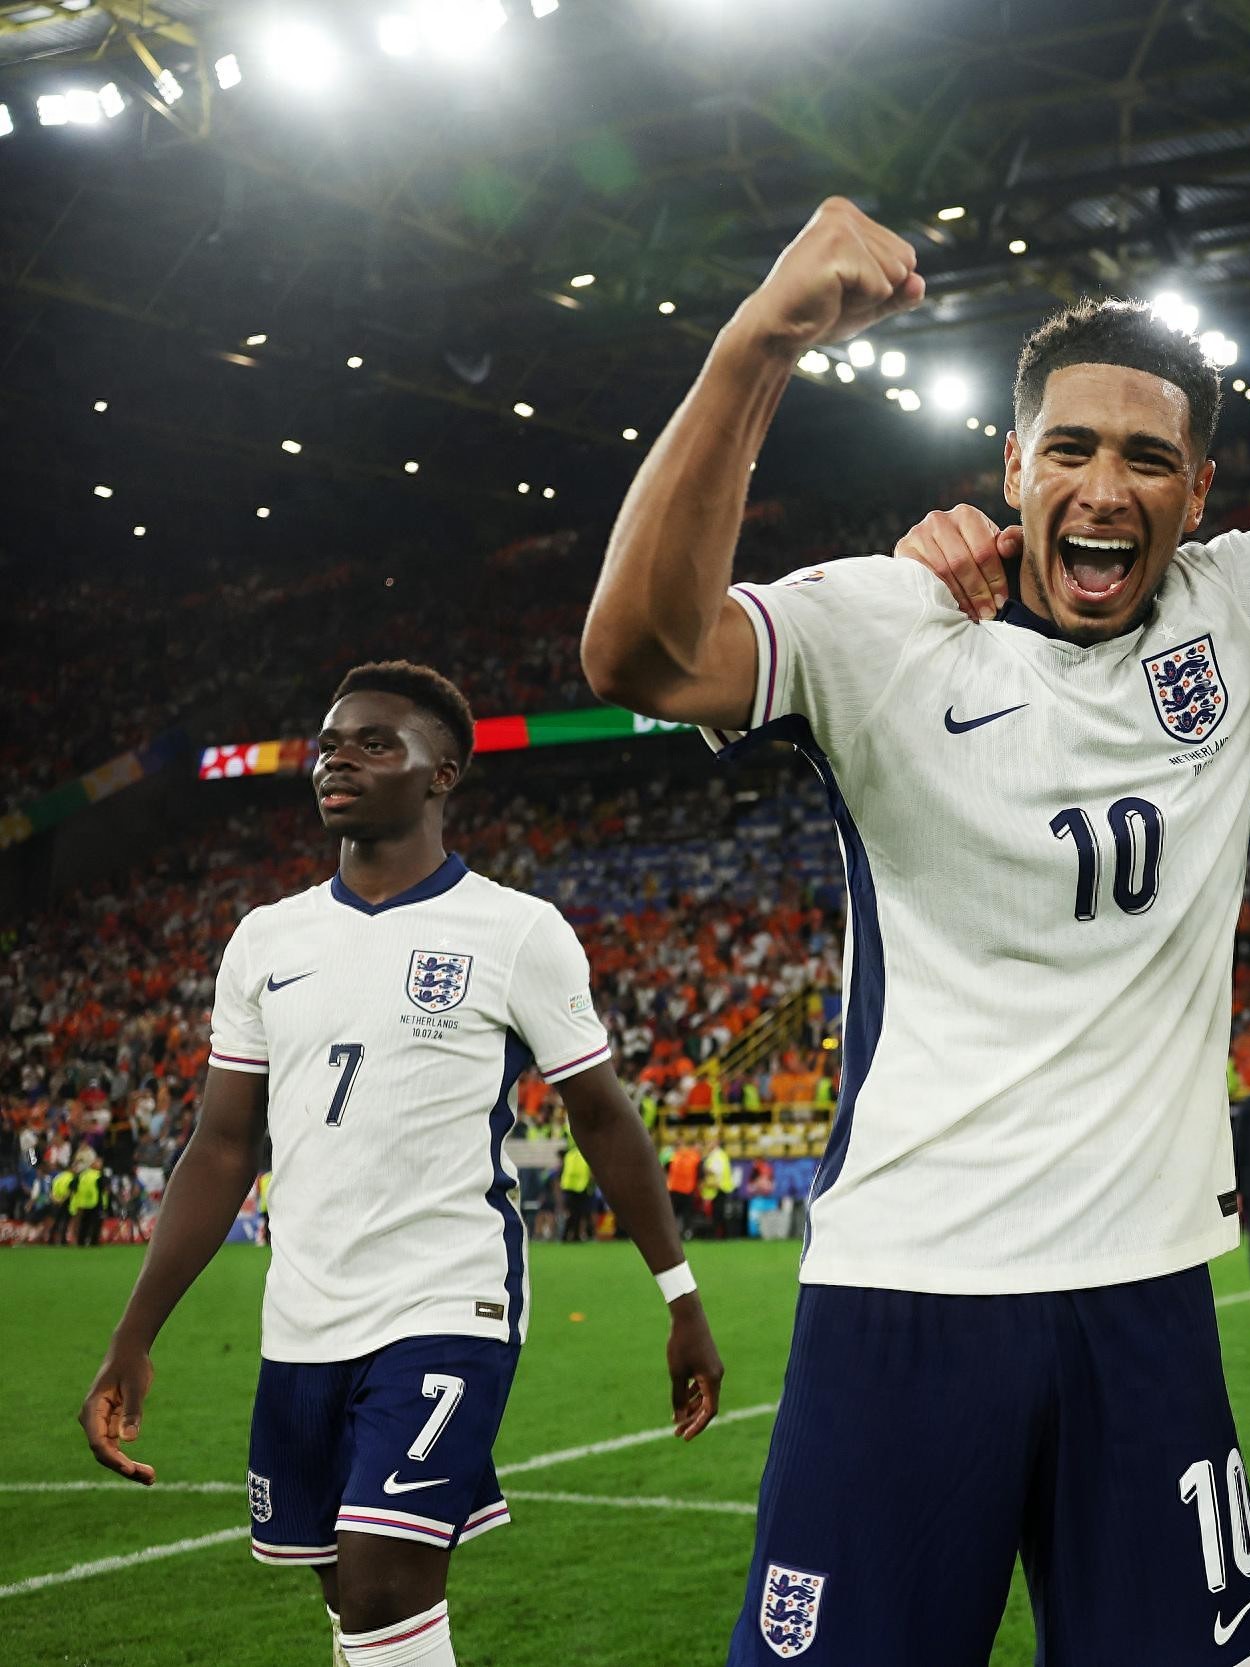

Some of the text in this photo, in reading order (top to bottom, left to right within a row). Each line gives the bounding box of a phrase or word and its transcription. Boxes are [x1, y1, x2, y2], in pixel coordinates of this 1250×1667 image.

[1049, 797, 1165, 922] 10
[400, 1014, 459, 1030] NETHERLANDS
[412, 1027, 443, 1040] 10.07.24
[326, 1043, 365, 1127] 7
[407, 1373, 465, 1462] 7
